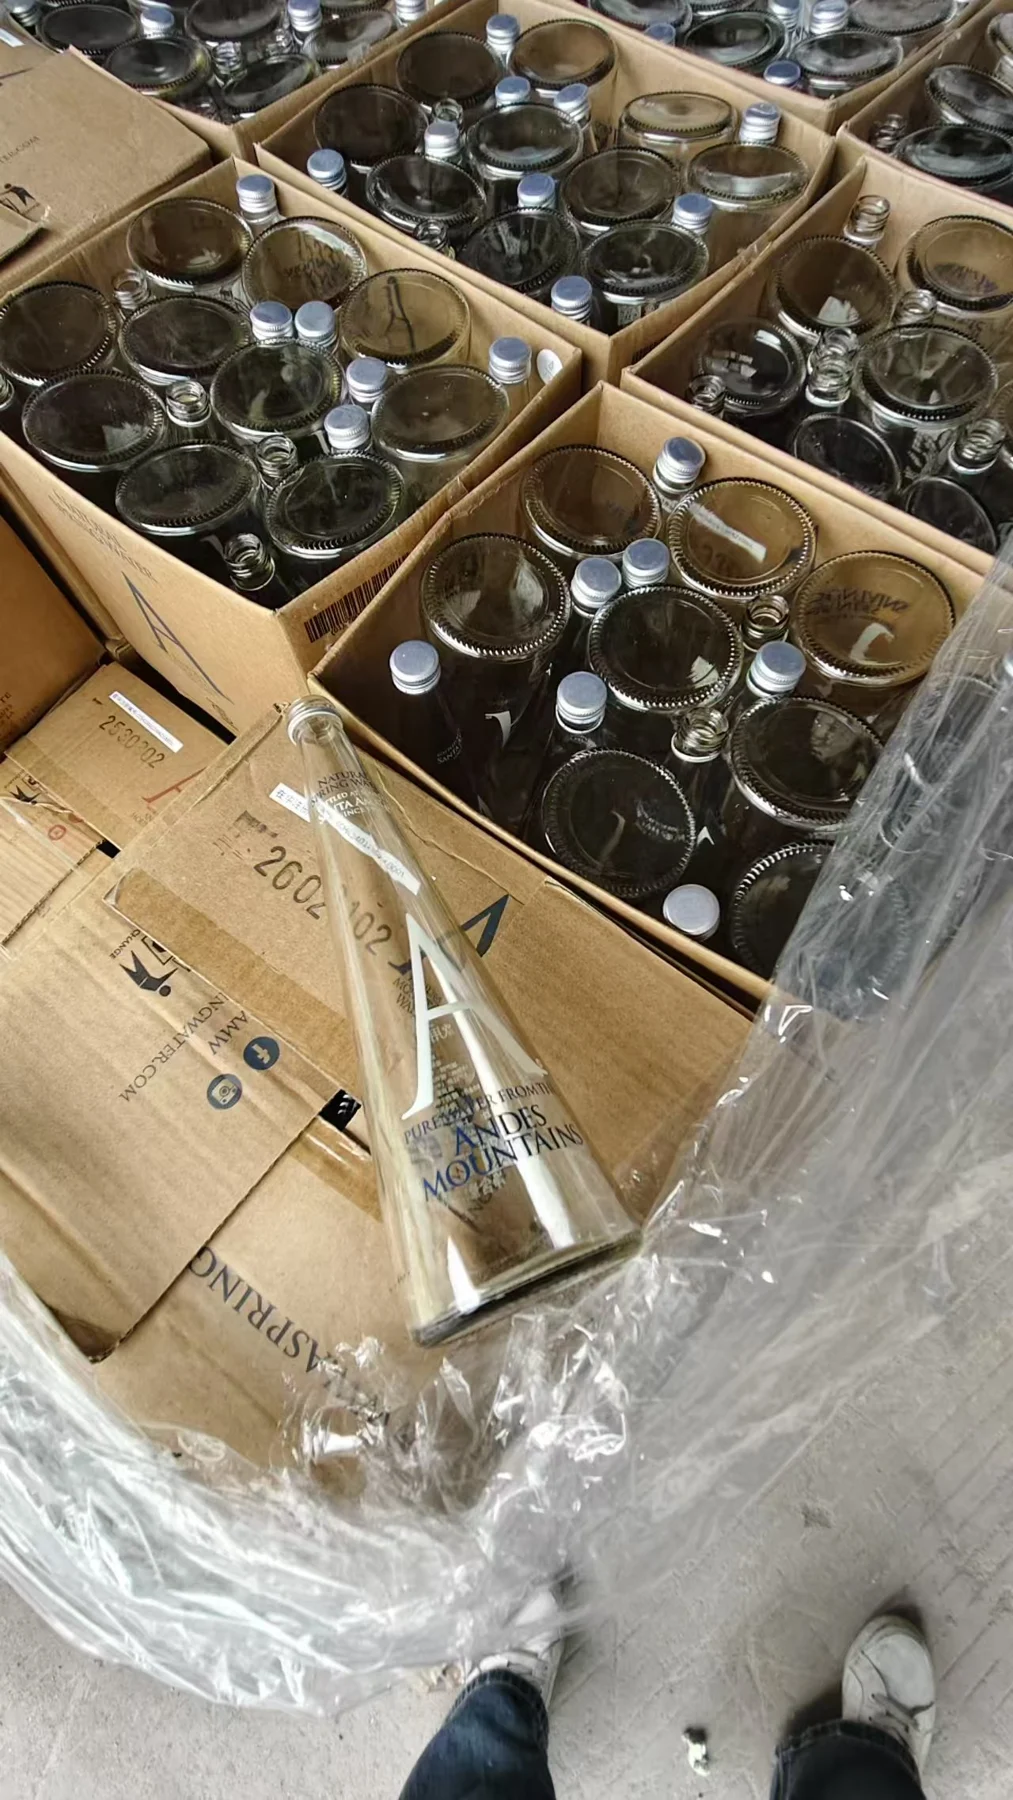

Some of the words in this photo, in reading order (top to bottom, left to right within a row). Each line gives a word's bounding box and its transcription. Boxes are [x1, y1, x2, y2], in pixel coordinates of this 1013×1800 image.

[208, 1010, 250, 1056] AMW
[401, 912, 549, 1121] A
[498, 1081, 541, 1103] FROM
[456, 1104, 547, 1158] ANDES
[423, 1123, 584, 1203] MOUNTAINS
